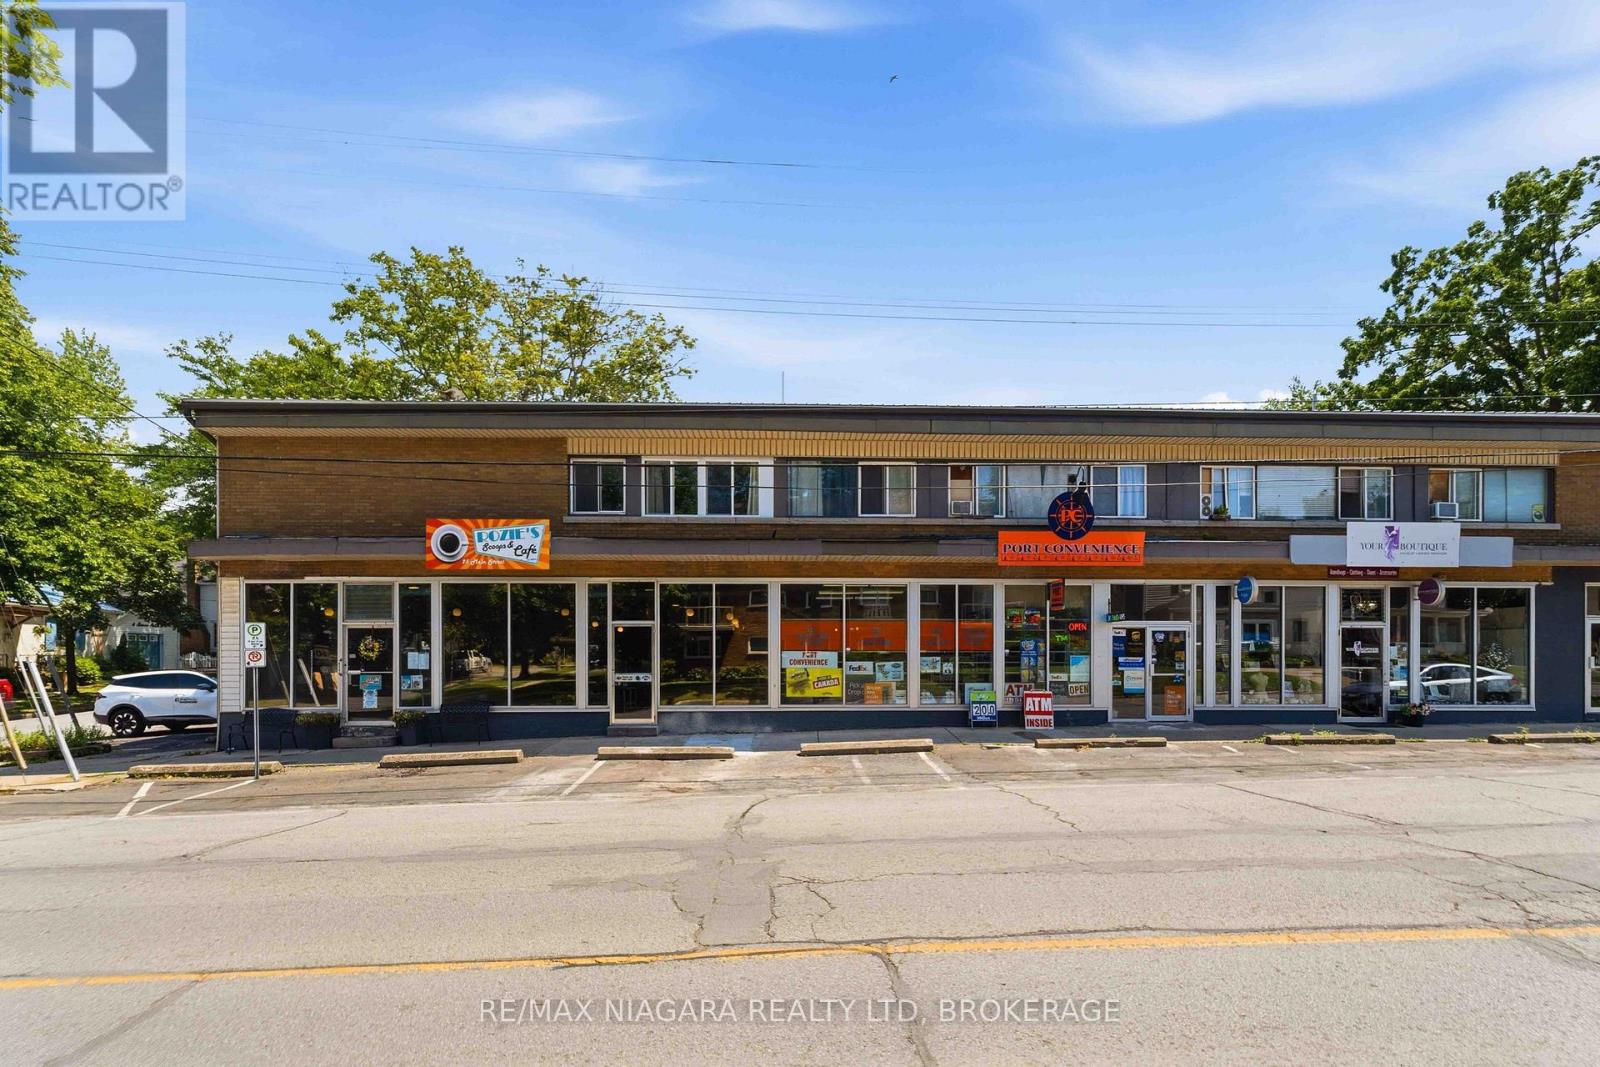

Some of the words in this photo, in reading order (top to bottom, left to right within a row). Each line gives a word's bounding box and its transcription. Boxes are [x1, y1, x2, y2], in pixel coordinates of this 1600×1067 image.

[1060, 509, 1083, 523] PC
[514, 544, 538, 559] Café
[1003, 543, 1039, 553] PORT
[1044, 543, 1138, 554] CONVENIENCE
[1360, 542, 1383, 551] YOUR
[1400, 542, 1448, 551] BOUTIQUE
[1068, 622, 1088, 631] OPEN
[789, 658, 829, 666] CONVENIENCE
[1069, 685, 1089, 694] OPEN
[1025, 697, 1052, 711] ATM
[1026, 718, 1053, 728] INSIDE
